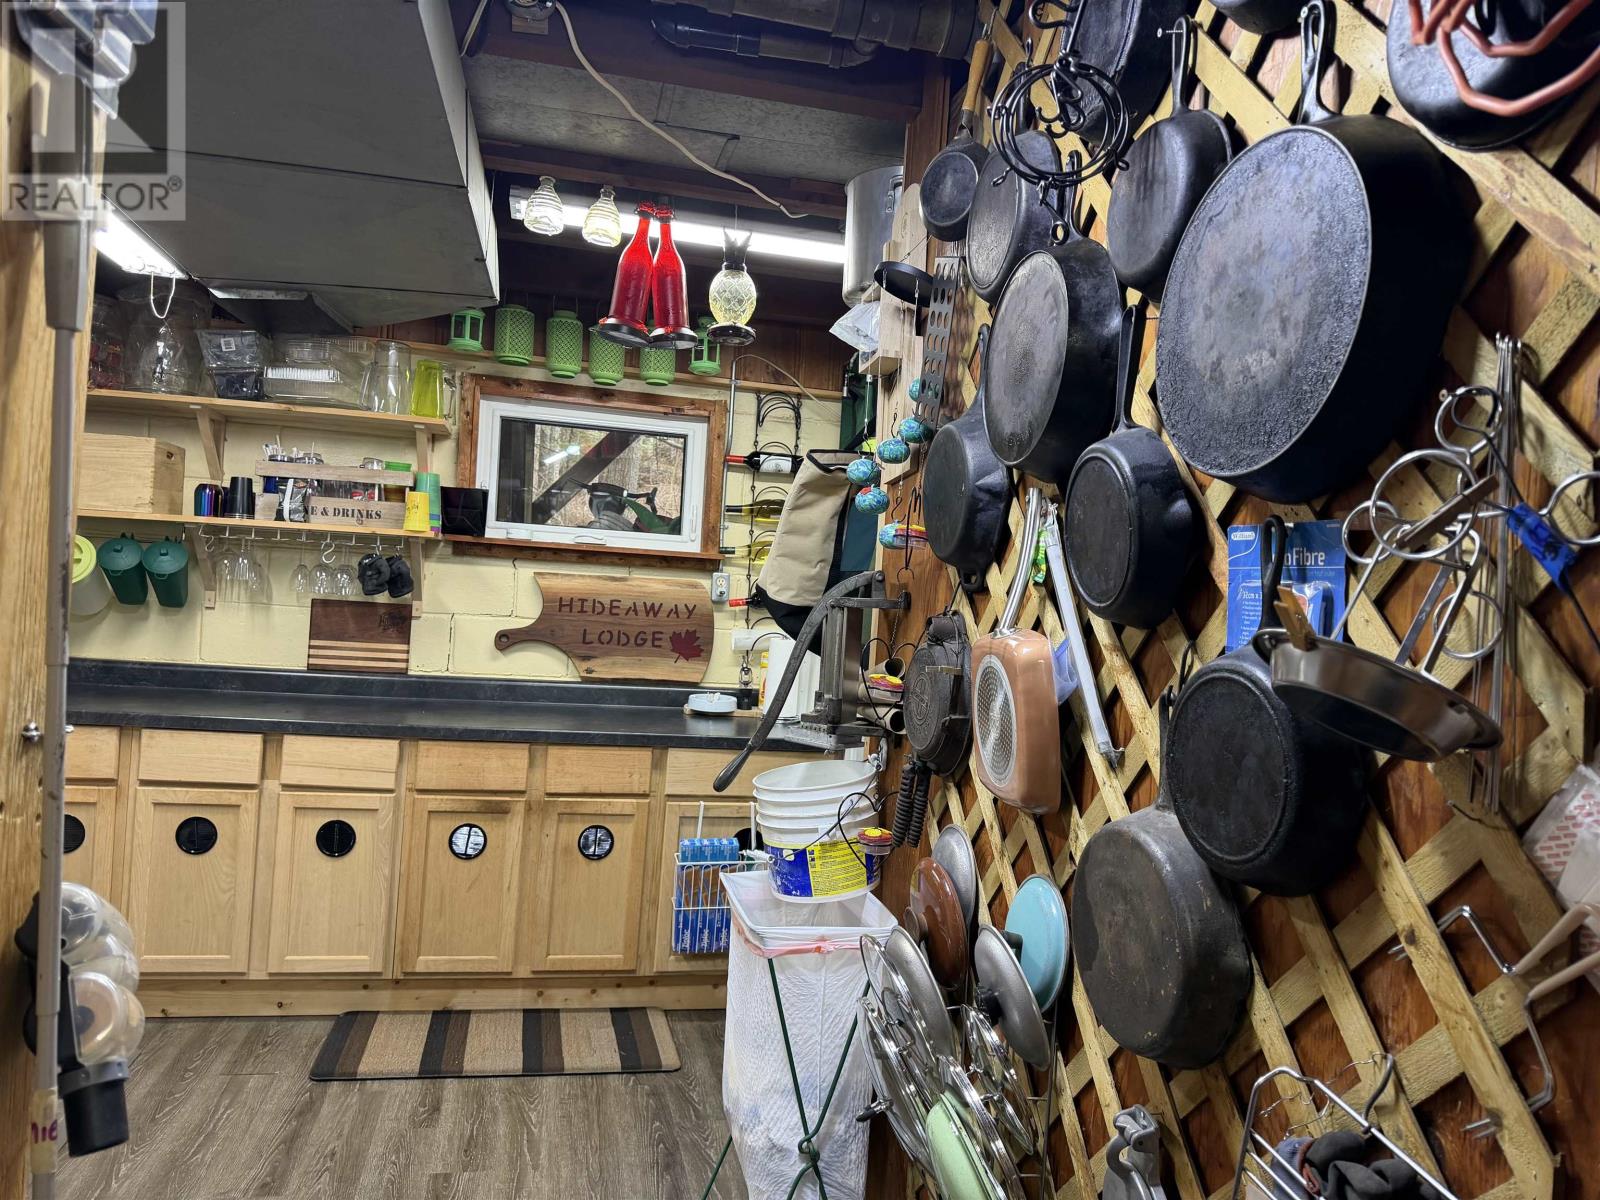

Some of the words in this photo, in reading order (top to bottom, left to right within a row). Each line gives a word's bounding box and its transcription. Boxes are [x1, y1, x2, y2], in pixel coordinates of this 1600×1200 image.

[320, 507, 330, 517] &
[332, 507, 382, 520] DRINKS
[1284, 547, 1325, 566] oFibre
[558, 597, 697, 619] HIDEAWAY
[582, 628, 664, 648] LODGE
